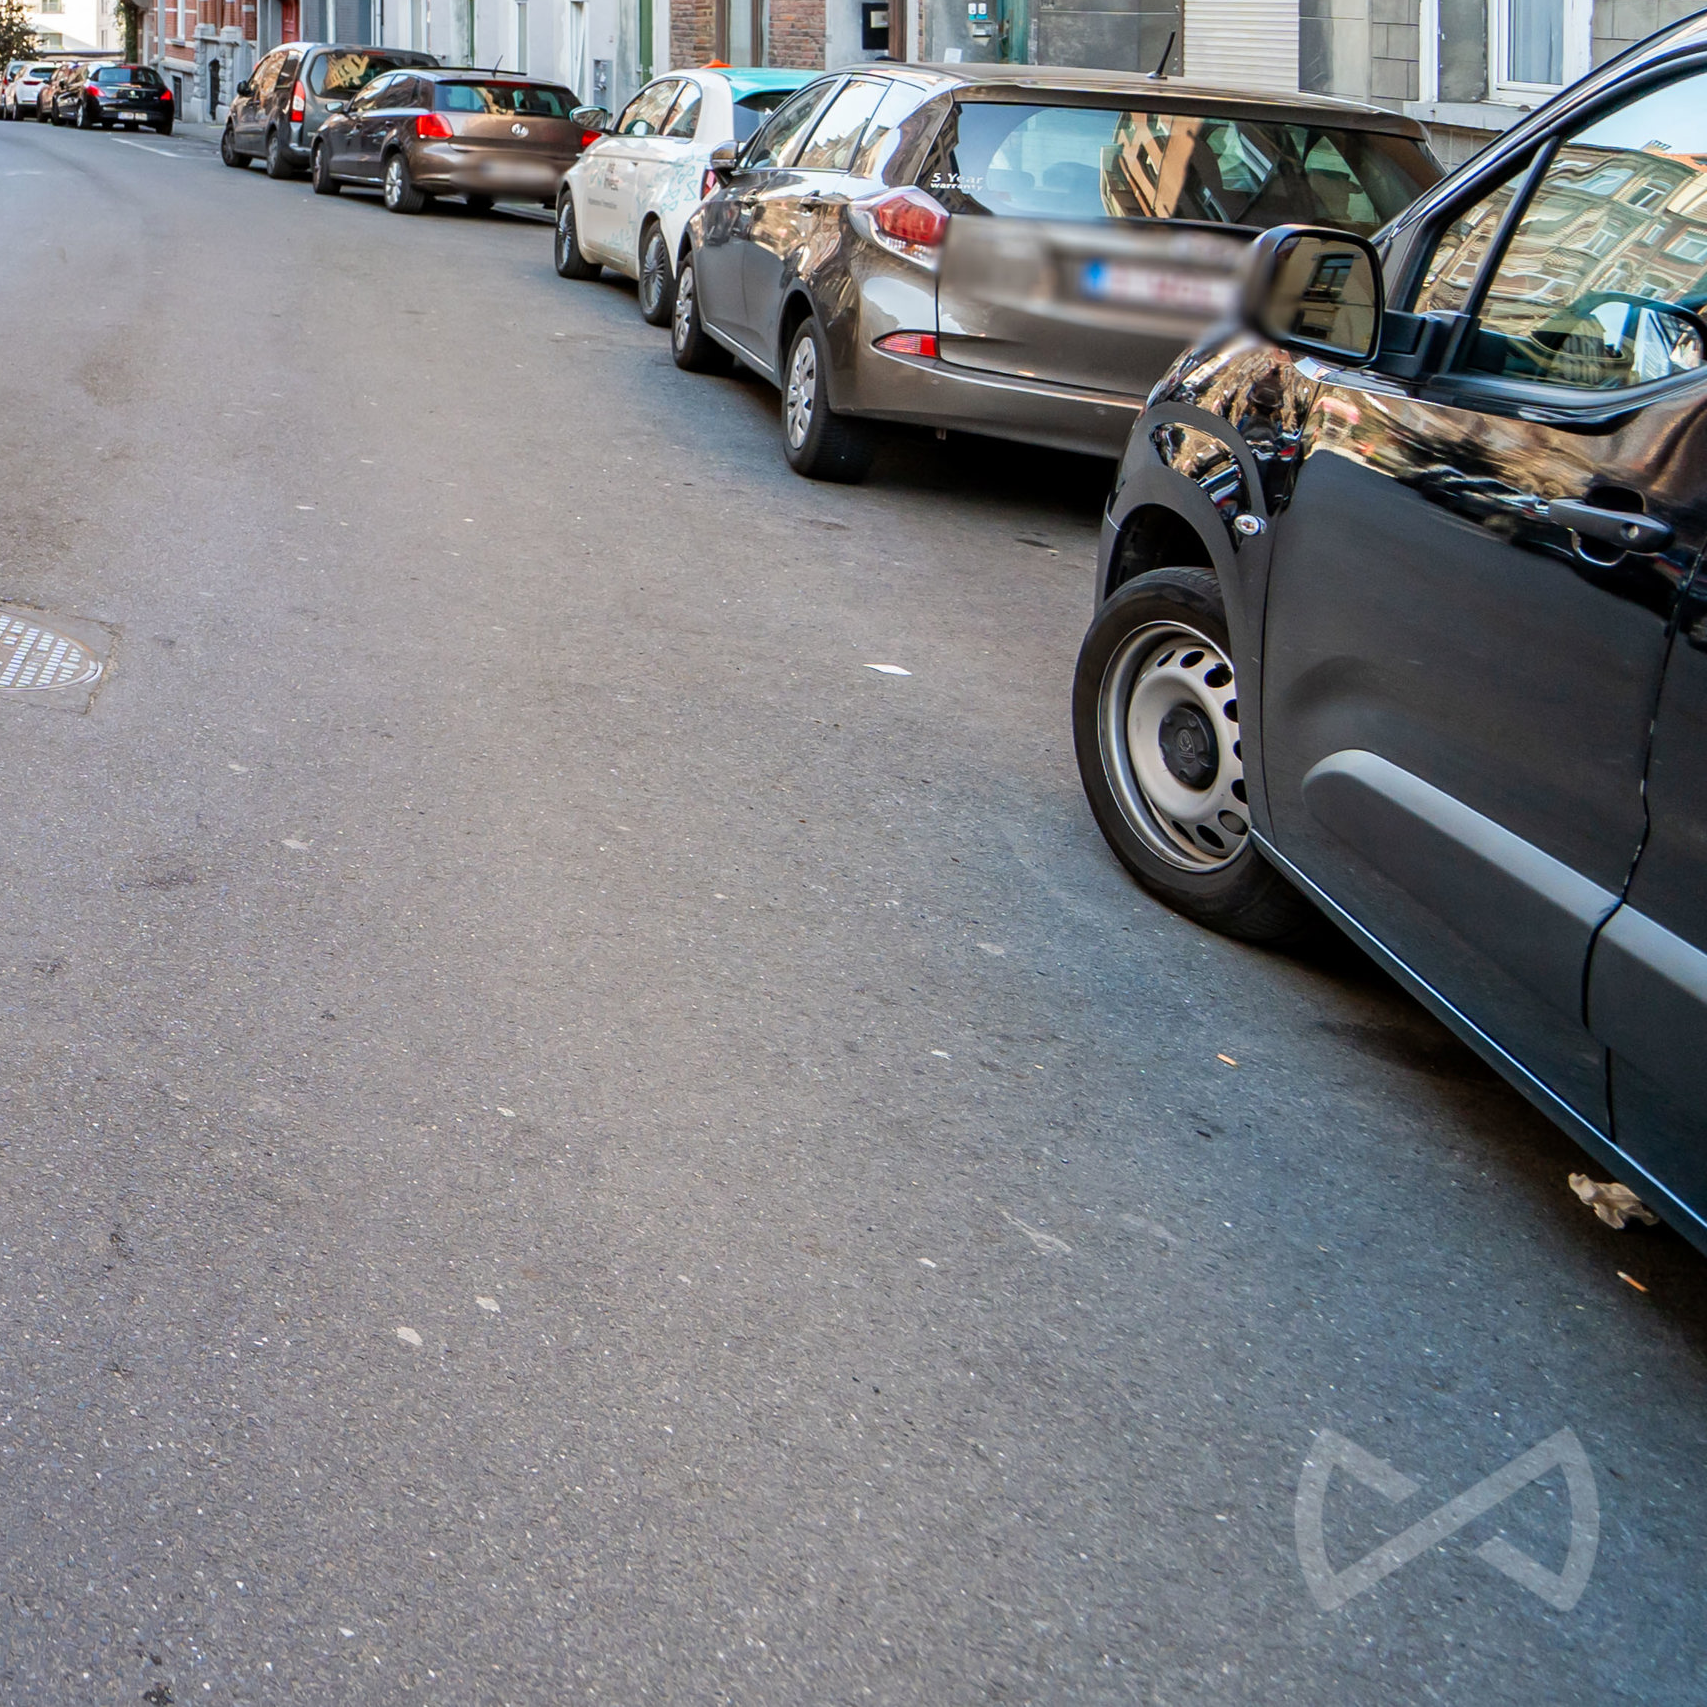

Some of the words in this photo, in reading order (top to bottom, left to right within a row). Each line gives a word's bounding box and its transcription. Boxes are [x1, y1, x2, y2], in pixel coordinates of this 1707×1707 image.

[931, 173, 941, 183] 5
[947, 173, 983, 184] Year
[930, 183, 983, 191] warranty
